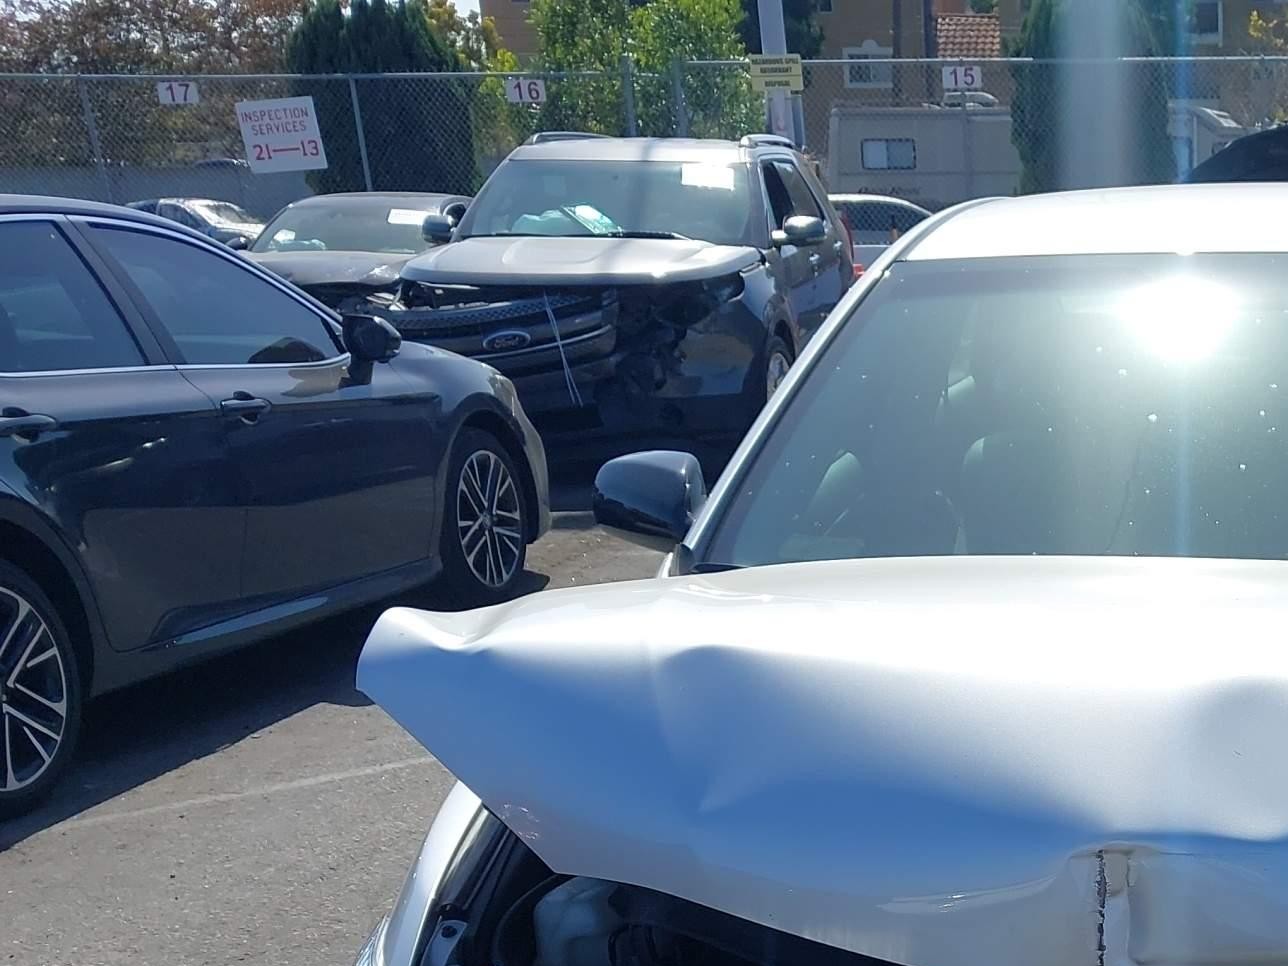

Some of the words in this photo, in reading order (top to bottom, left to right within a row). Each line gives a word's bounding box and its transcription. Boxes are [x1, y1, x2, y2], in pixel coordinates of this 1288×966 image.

[949, 67, 976, 86] 15
[166, 83, 190, 102] 17
[513, 81, 540, 100] 16
[240, 106, 309, 122] INSPECTION
[251, 120, 307, 136] SERVICES
